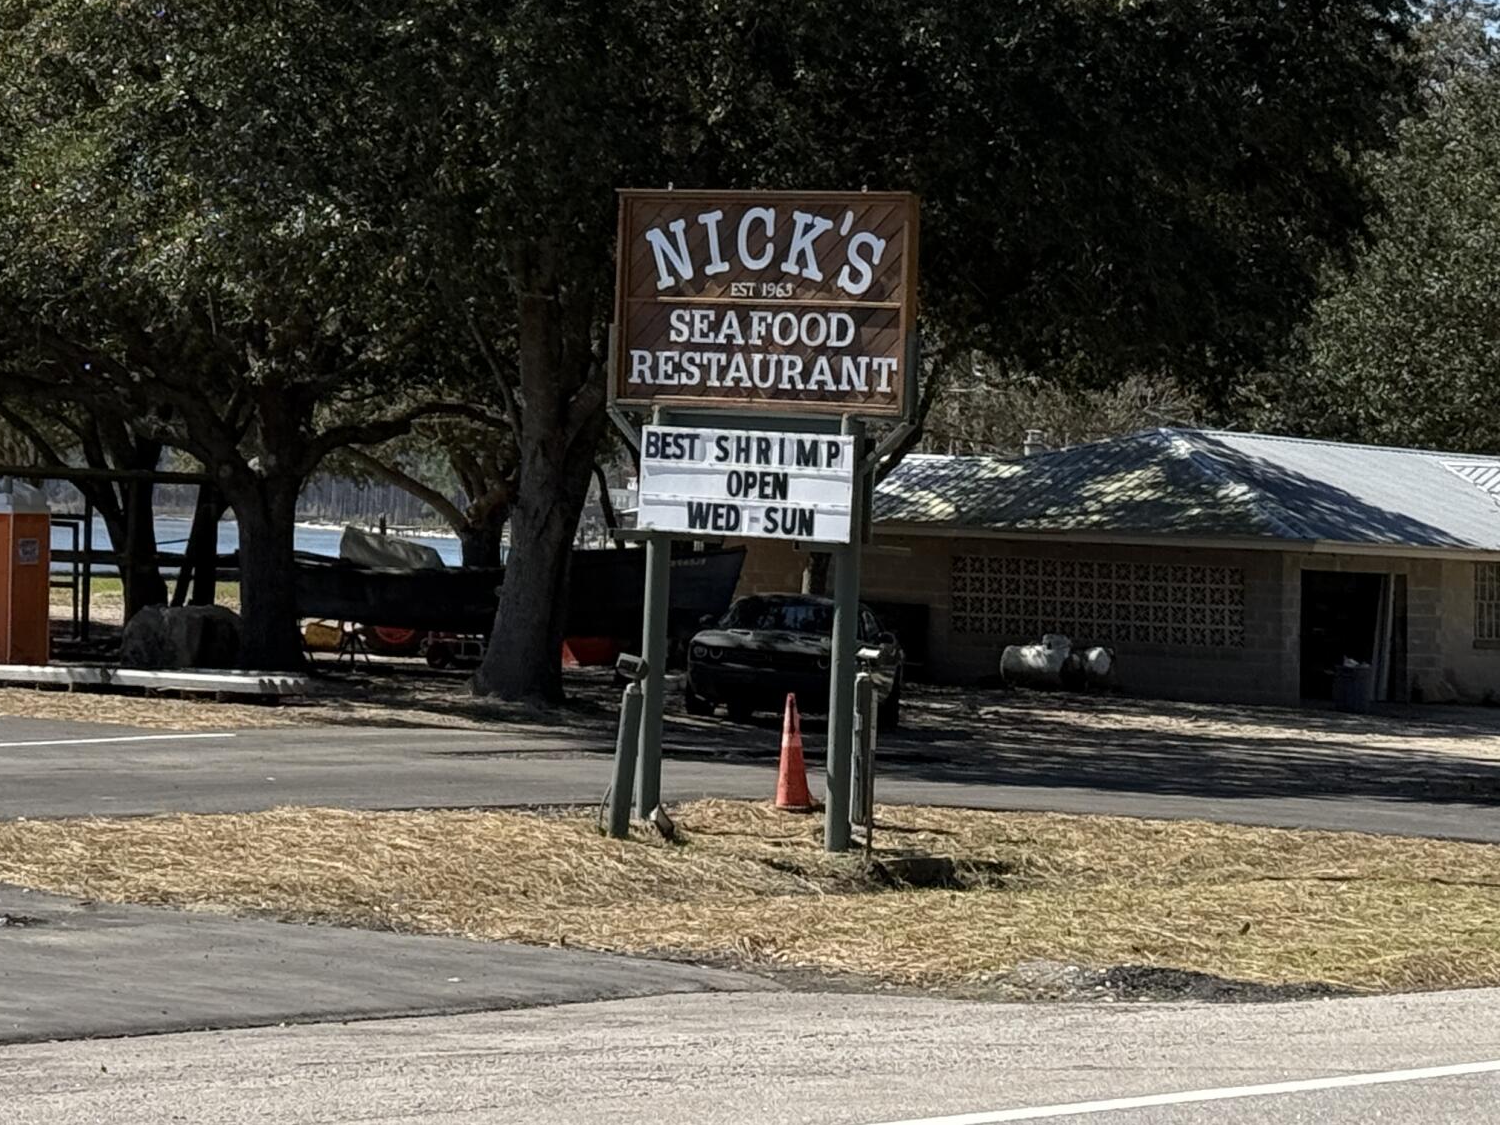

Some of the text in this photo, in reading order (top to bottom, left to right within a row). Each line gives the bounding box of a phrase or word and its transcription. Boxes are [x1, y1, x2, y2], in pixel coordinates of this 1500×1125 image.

[645, 206, 887, 296] NICK'S
[730, 282, 794, 299] EST 1963
[668, 308, 856, 349] SEAFOOD
[627, 349, 898, 394] RESTAURANT
[645, 431, 841, 469] BEST SHRIMP
[726, 470, 789, 501] OPEN
[686, 501, 741, 532] WED
[762, 506, 816, 537] SUN
